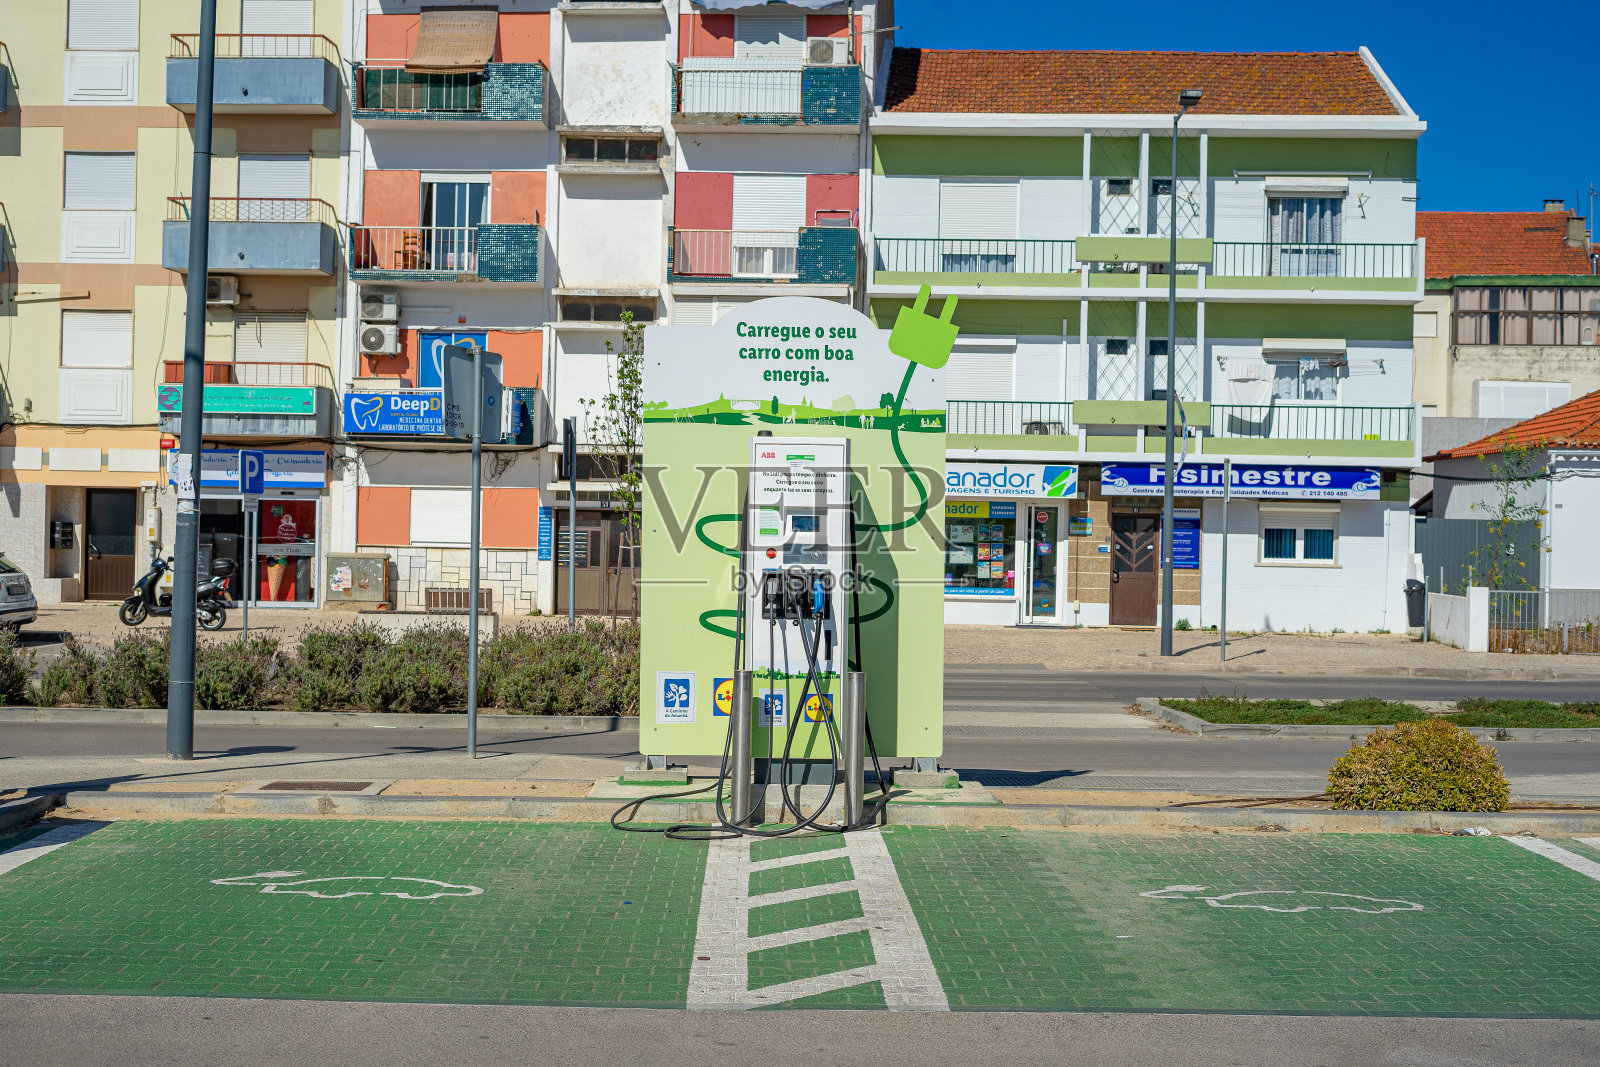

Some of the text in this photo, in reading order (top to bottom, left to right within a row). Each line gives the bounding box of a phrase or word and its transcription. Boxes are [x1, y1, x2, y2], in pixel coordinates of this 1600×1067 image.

[736, 321, 857, 342] Carregue o seu
[738, 344, 854, 361] carro com boa
[763, 365, 830, 386] energia.
[424, 416, 442, 424] DENTÁR
[378, 423, 409, 432] LABORATÓRIO
[410, 424, 416, 432] DE
[416, 423, 436, 432] PRÓTESE
[201, 455, 228, 463] adaria
[245, 455, 259, 490] P
[946, 465, 1035, 488] anador
[1211, 488, 1260, 497] Espialidades
[1261, 488, 1289, 496] Médicas
[945, 503, 979, 515] nador
